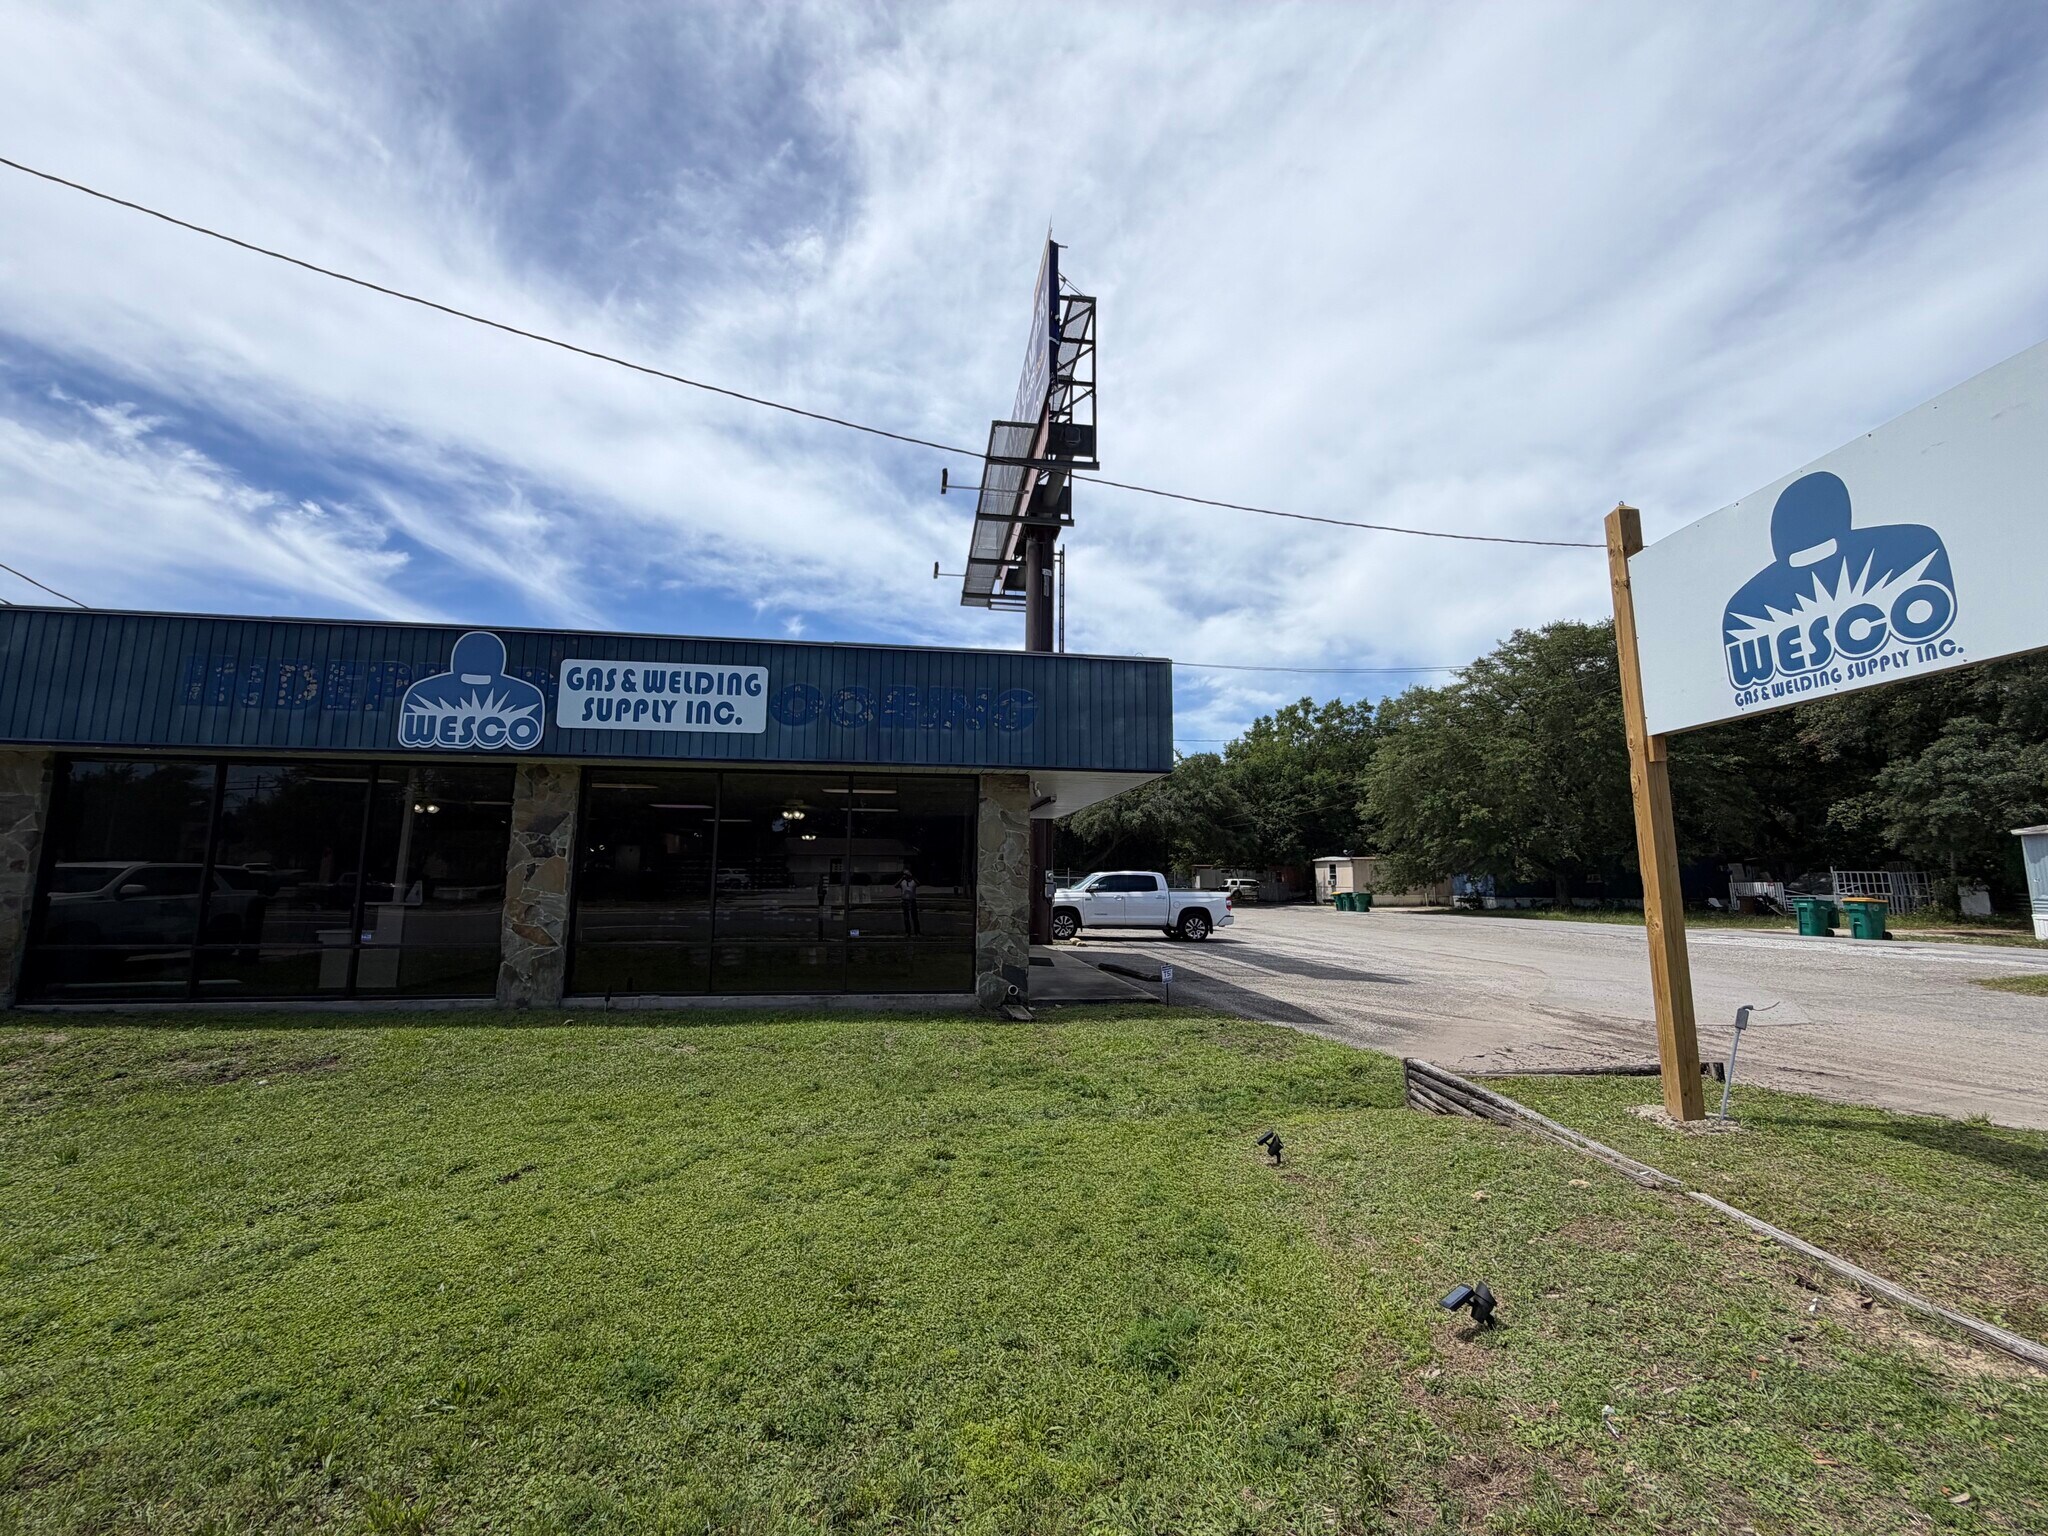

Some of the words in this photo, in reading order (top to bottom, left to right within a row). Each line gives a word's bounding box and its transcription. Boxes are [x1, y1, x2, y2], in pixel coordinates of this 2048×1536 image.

[1728, 583, 1952, 687] WESCO
[1847, 649, 1910, 681] SUPPLY
[1916, 638, 1965, 664] INC.
[403, 714, 539, 745] WESCO
[581, 697, 678, 724] SUPPLY
[685, 700, 743, 726] INC.
